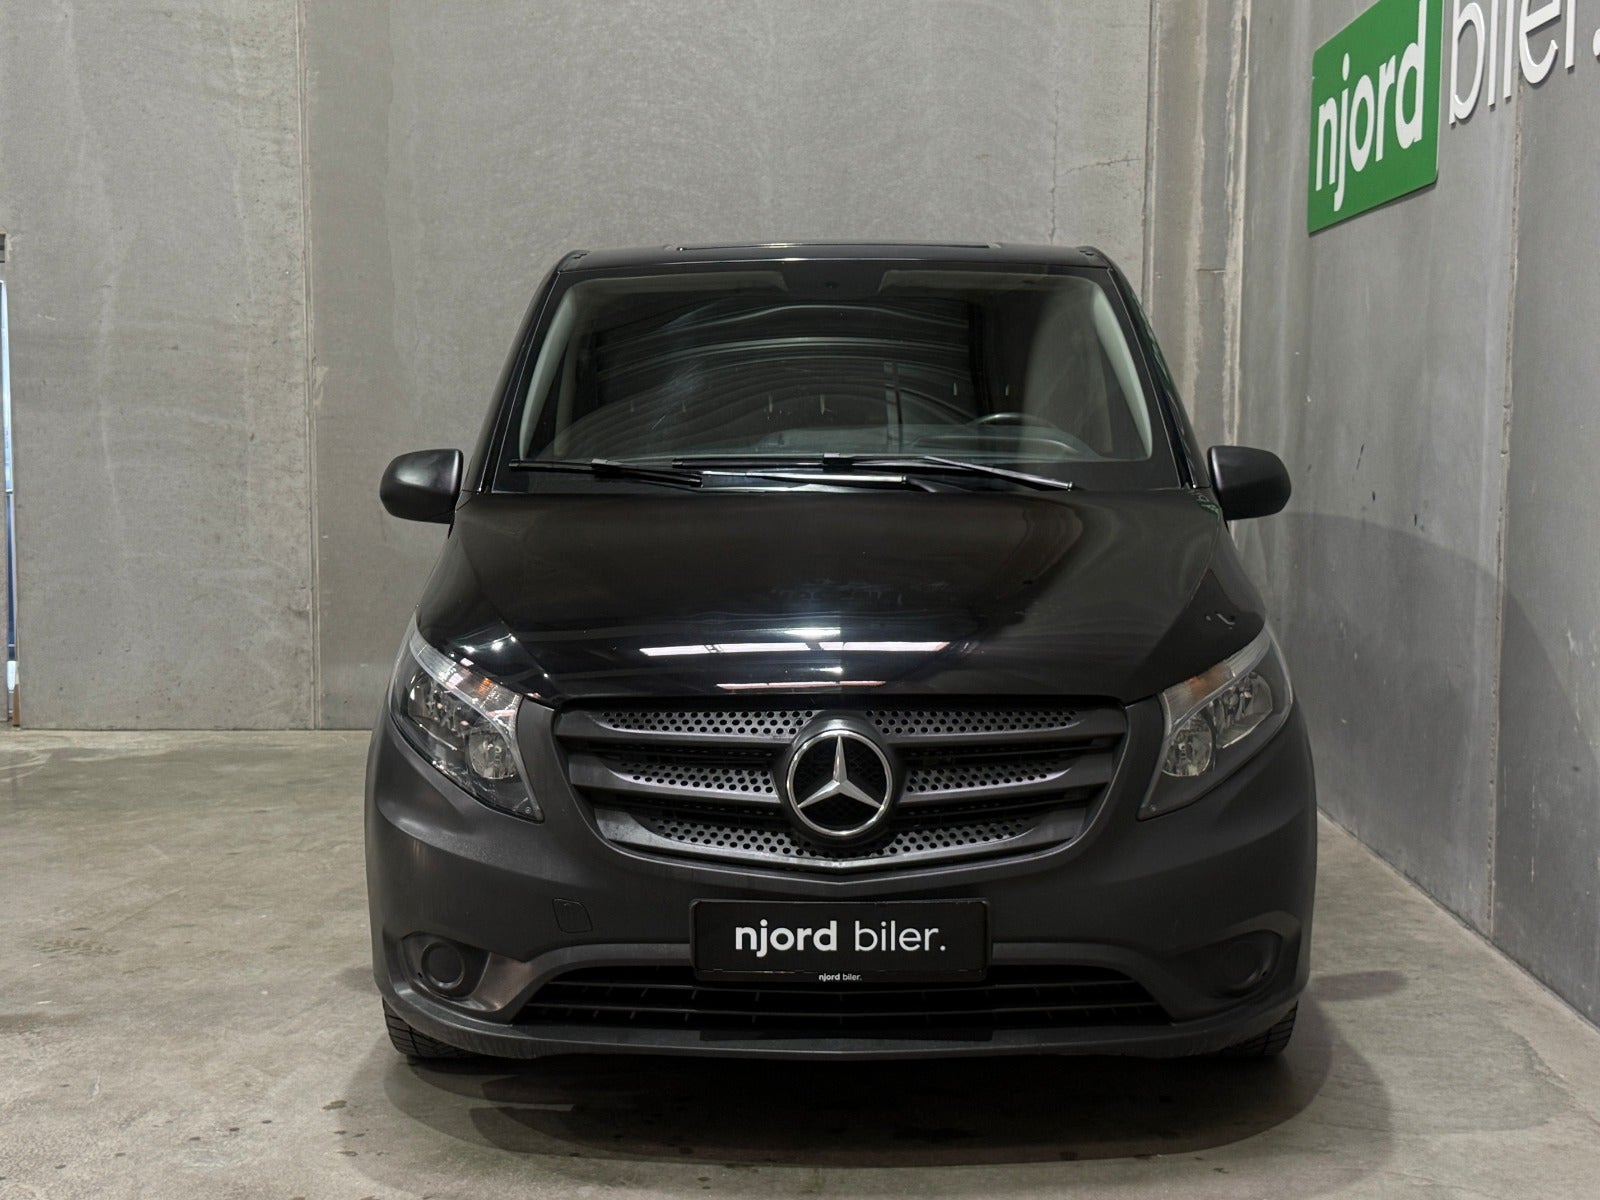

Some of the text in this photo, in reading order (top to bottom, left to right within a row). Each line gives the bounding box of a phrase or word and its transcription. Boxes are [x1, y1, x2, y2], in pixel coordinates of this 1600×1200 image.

[1315, 0, 1427, 212] njord
[735, 919, 946, 958] njord biler.
[818, 972, 862, 982] njord biler.
